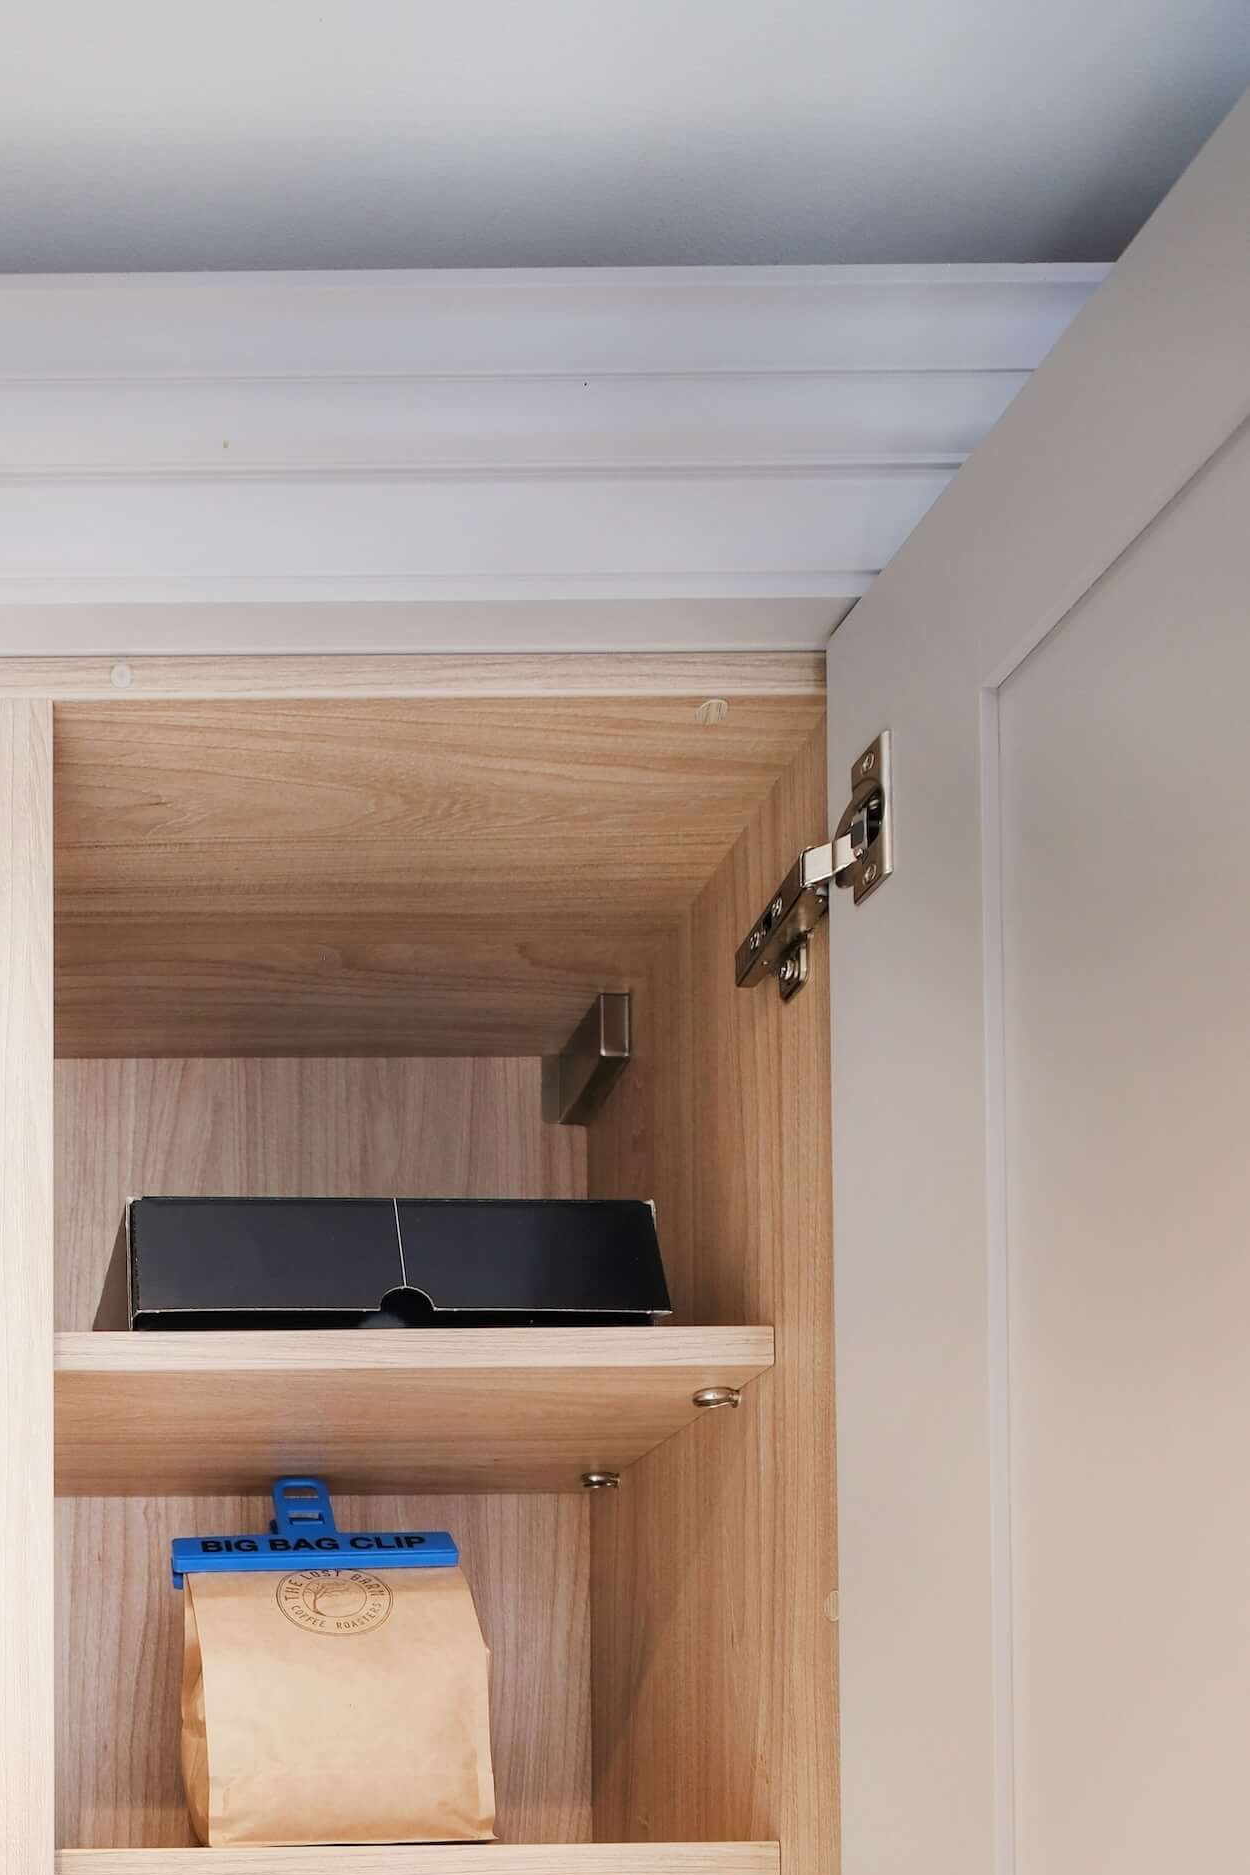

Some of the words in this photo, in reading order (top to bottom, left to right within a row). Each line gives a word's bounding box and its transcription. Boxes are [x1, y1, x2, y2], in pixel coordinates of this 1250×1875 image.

[200, 1538, 258, 1552] BIG
[269, 1537, 340, 1551] BAG
[349, 1535, 426, 1549] CLIP
[283, 1578, 304, 1601] THE
[349, 1573, 385, 1597] BARN
[290, 1604, 327, 1628] COFFEE
[336, 1601, 382, 1630] ROASTERS
